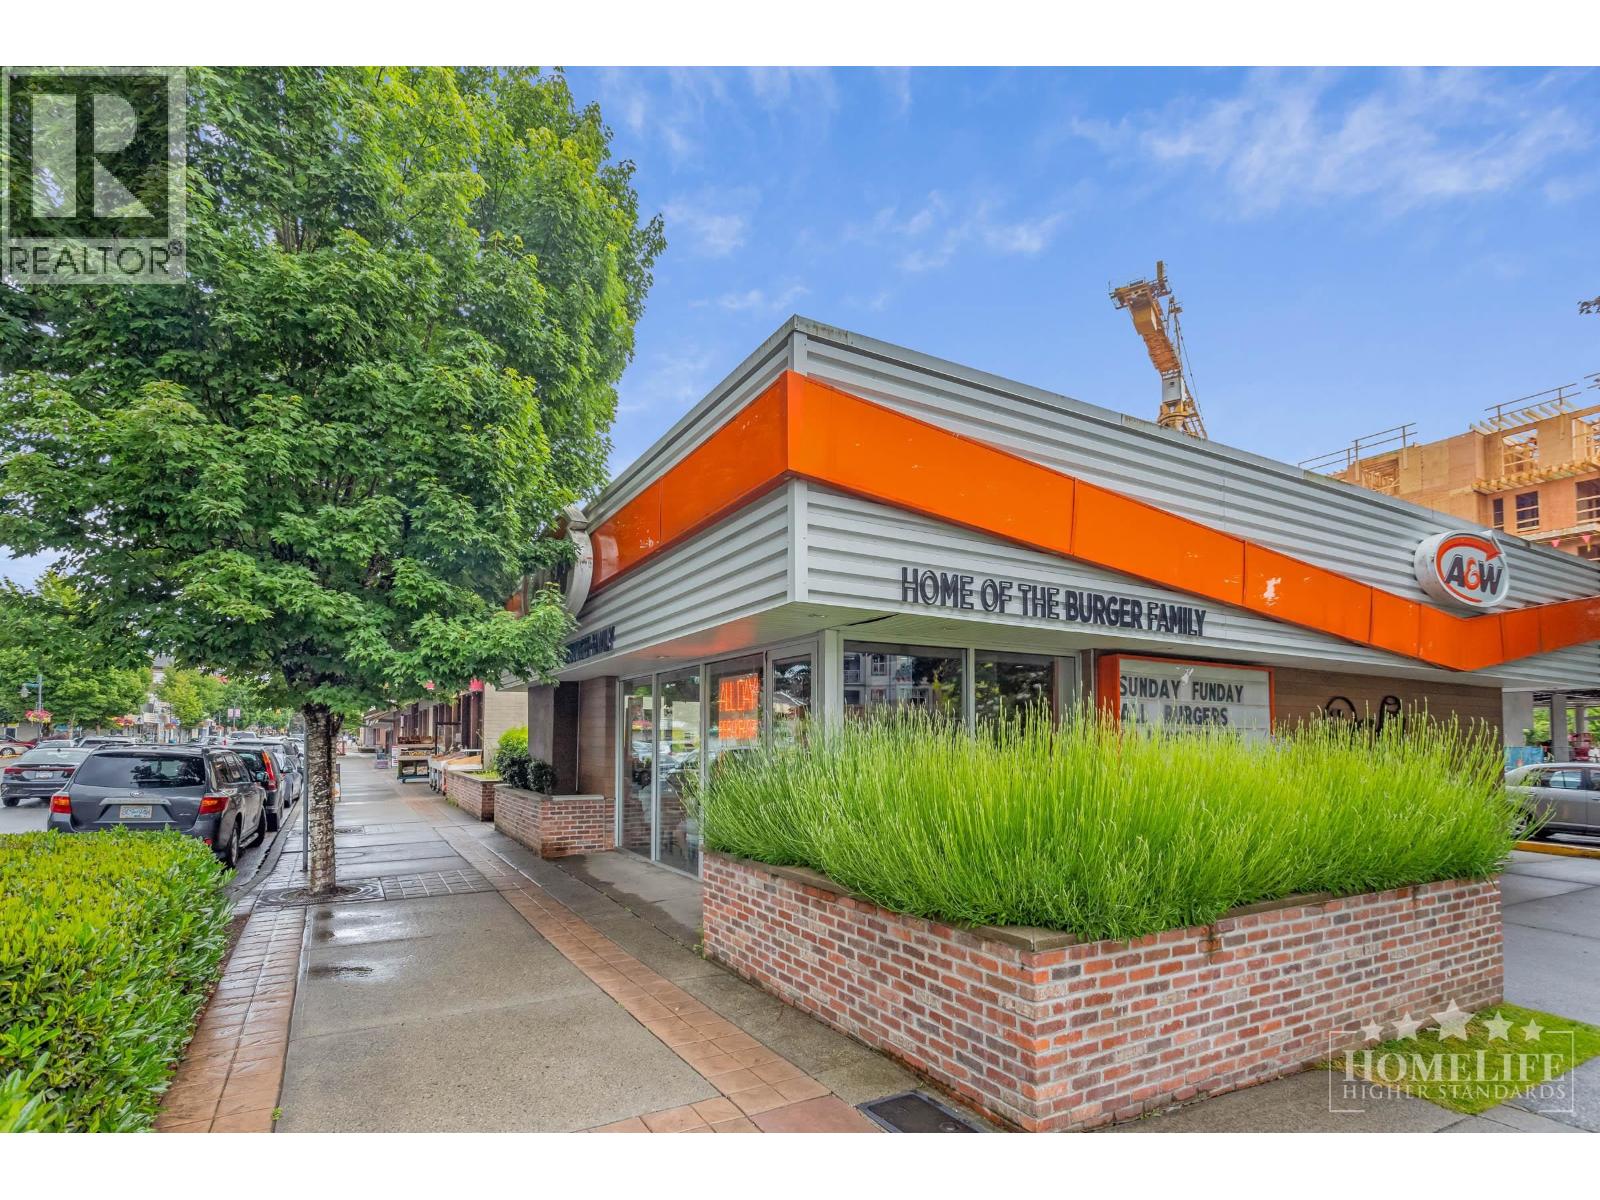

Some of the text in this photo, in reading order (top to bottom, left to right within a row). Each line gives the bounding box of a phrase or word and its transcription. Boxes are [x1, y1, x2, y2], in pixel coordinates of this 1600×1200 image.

[1445, 554, 1503, 595] A&W
[901, 566, 1207, 637] HOME OF THE BURGER FAMILY
[1119, 675, 1244, 703] SUNDAY FUNDAY
